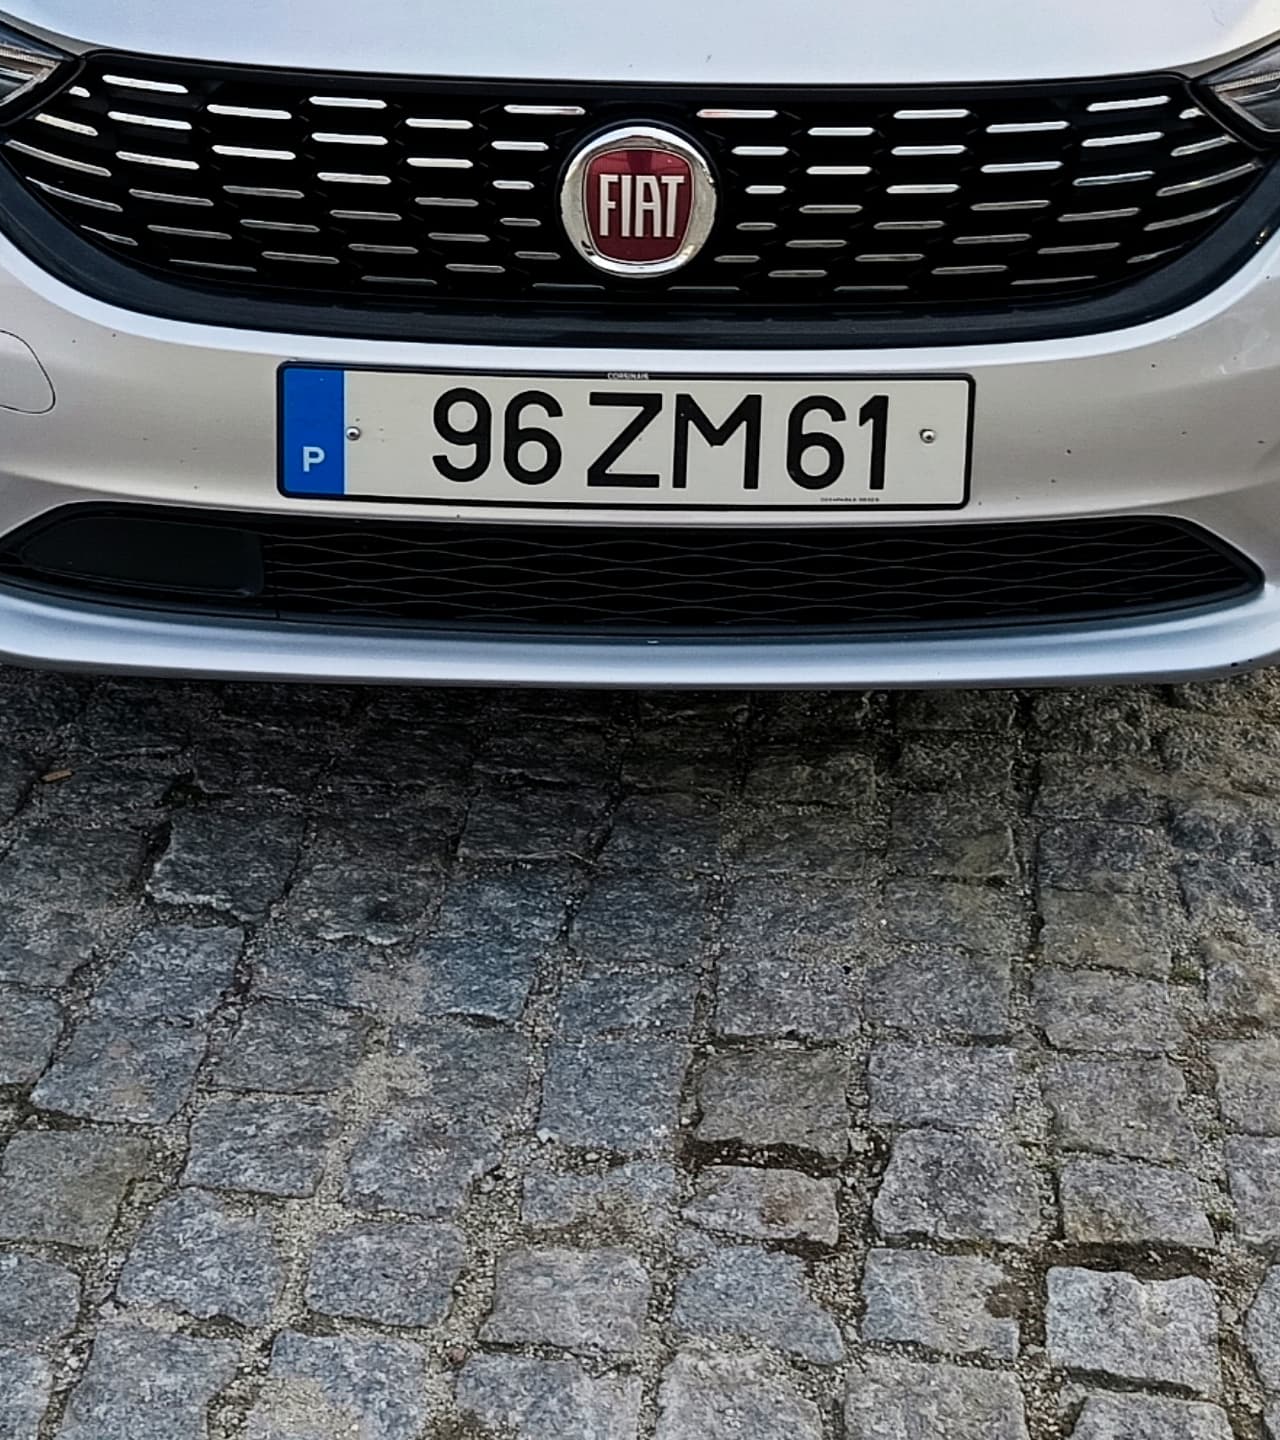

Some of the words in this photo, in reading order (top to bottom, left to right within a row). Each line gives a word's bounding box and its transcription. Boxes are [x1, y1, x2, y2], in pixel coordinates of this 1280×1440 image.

[600, 173, 685, 238] FIAT
[302, 446, 326, 473] P
[432, 387, 563, 486] 96
[587, 392, 763, 489] ZM
[786, 394, 889, 490] 61
